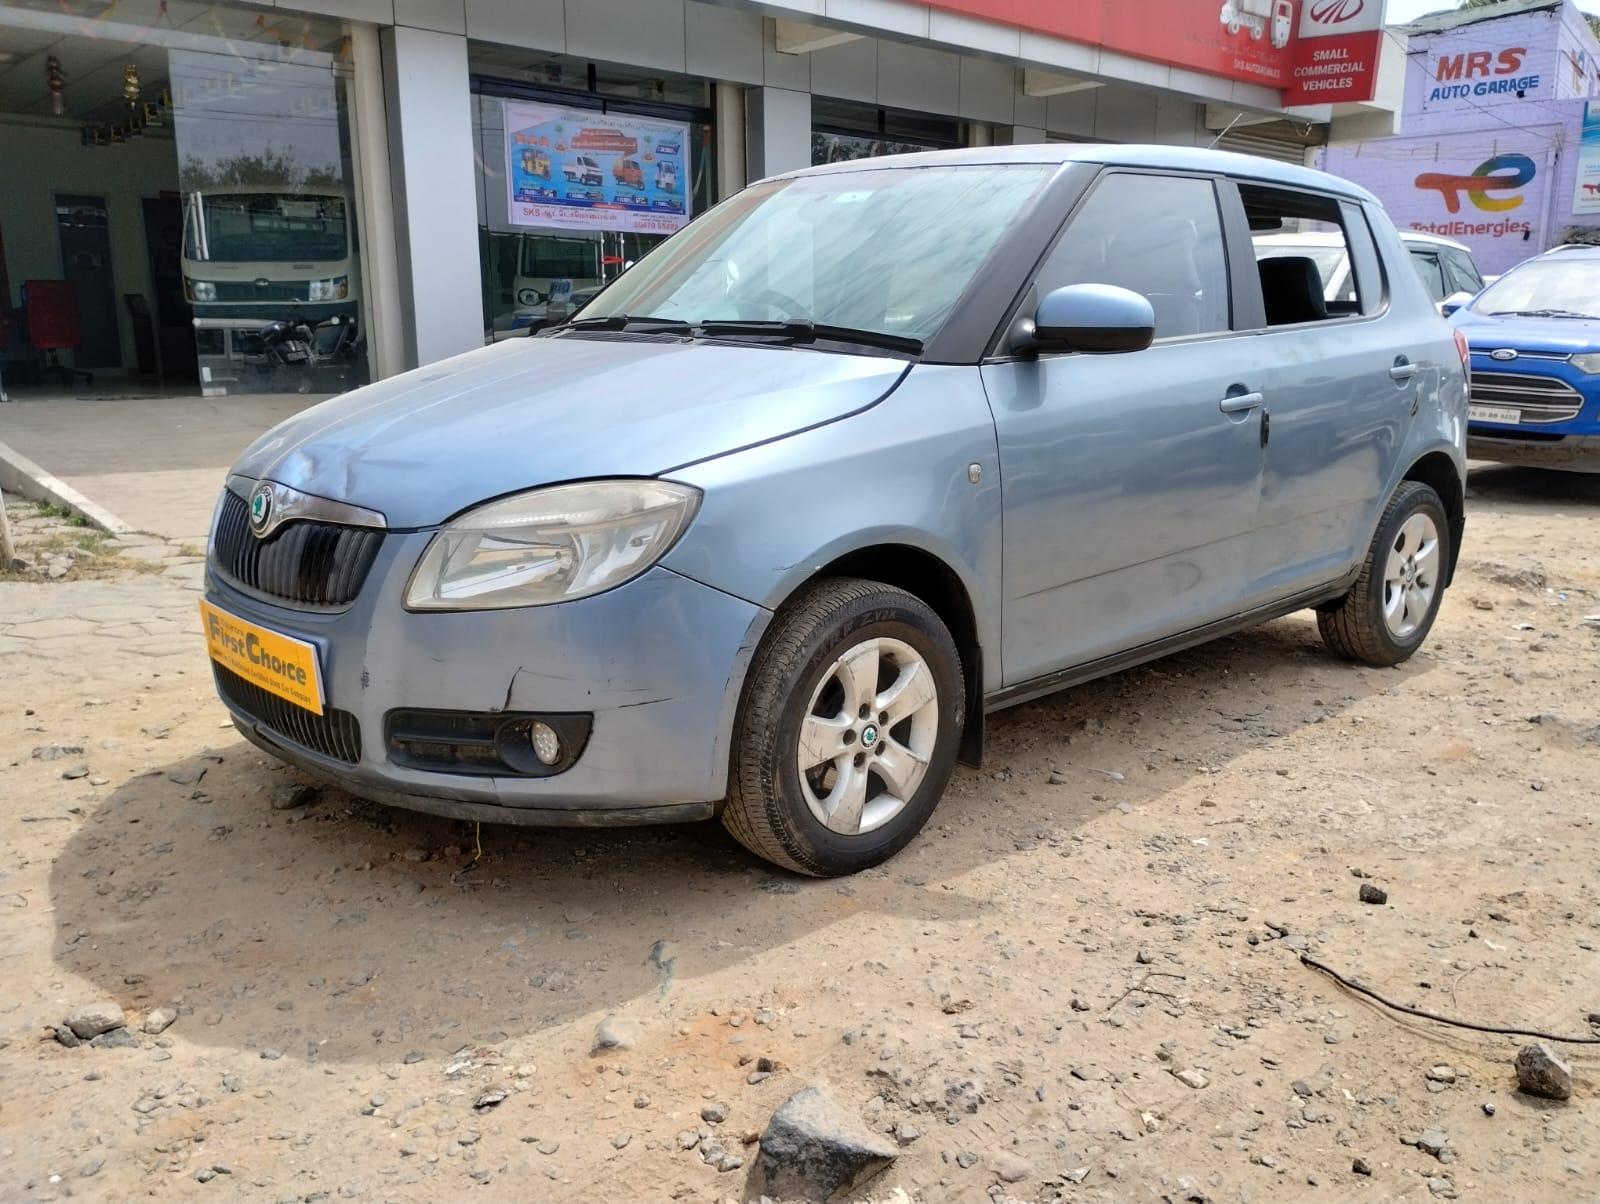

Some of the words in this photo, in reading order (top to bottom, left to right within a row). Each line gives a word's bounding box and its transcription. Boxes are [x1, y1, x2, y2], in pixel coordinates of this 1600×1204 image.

[1313, 48, 1349, 61] SMALL
[1294, 62, 1365, 77] COMMERCIAL
[1436, 47, 1527, 82] MRS
[1302, 77, 1352, 91] VEHICLES
[1430, 84, 1470, 101] AUTO
[1474, 75, 1540, 96] GARAGE
[523, 207, 540, 217] SKS
[1410, 218, 1531, 237] TotalEnergies
